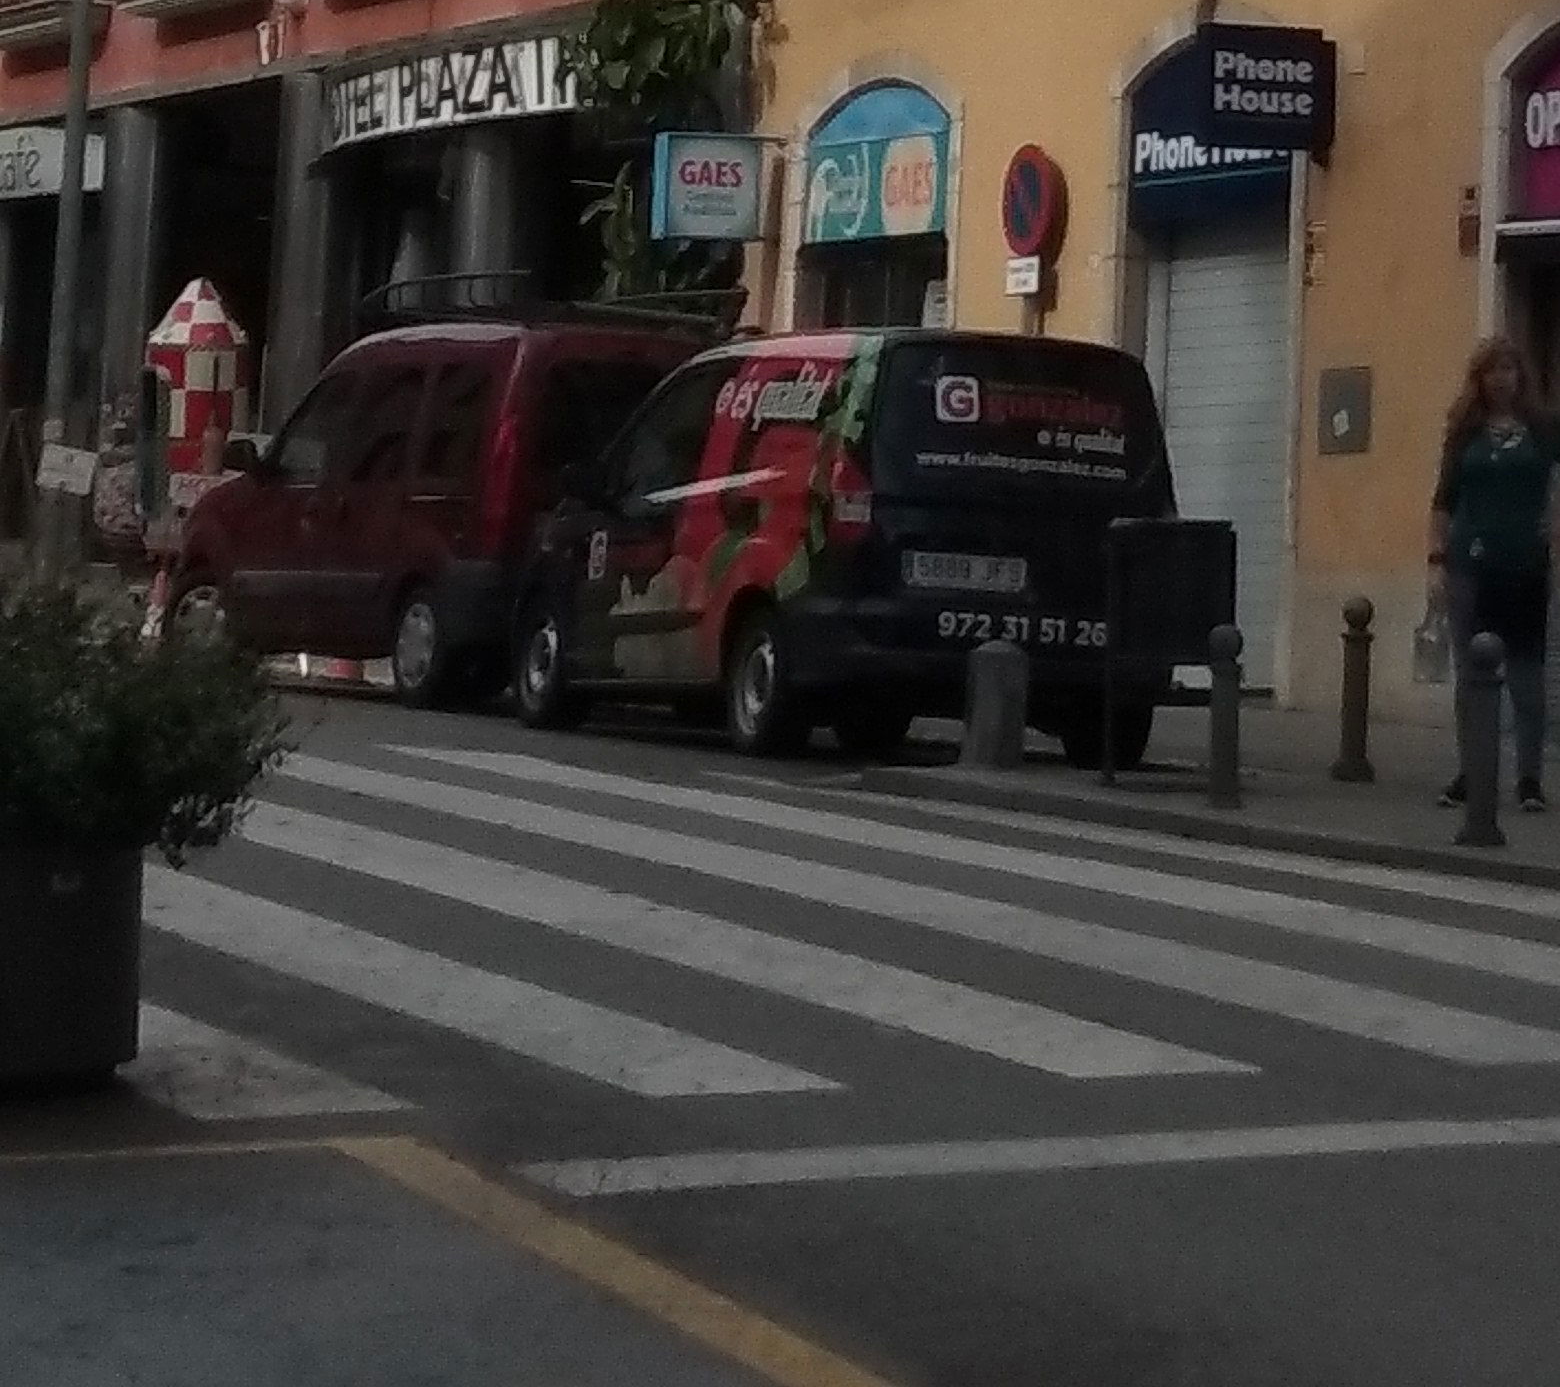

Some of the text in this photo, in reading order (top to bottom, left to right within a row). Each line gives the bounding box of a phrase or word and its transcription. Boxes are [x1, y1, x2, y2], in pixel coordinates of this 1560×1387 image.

[1213, 50, 1314, 83] Phone
[398, 38, 518, 129] PLAZA
[1213, 84, 1314, 115] House
[678, 160, 744, 188] GAES
[938, 611, 1109, 647] 972 31 51 26
